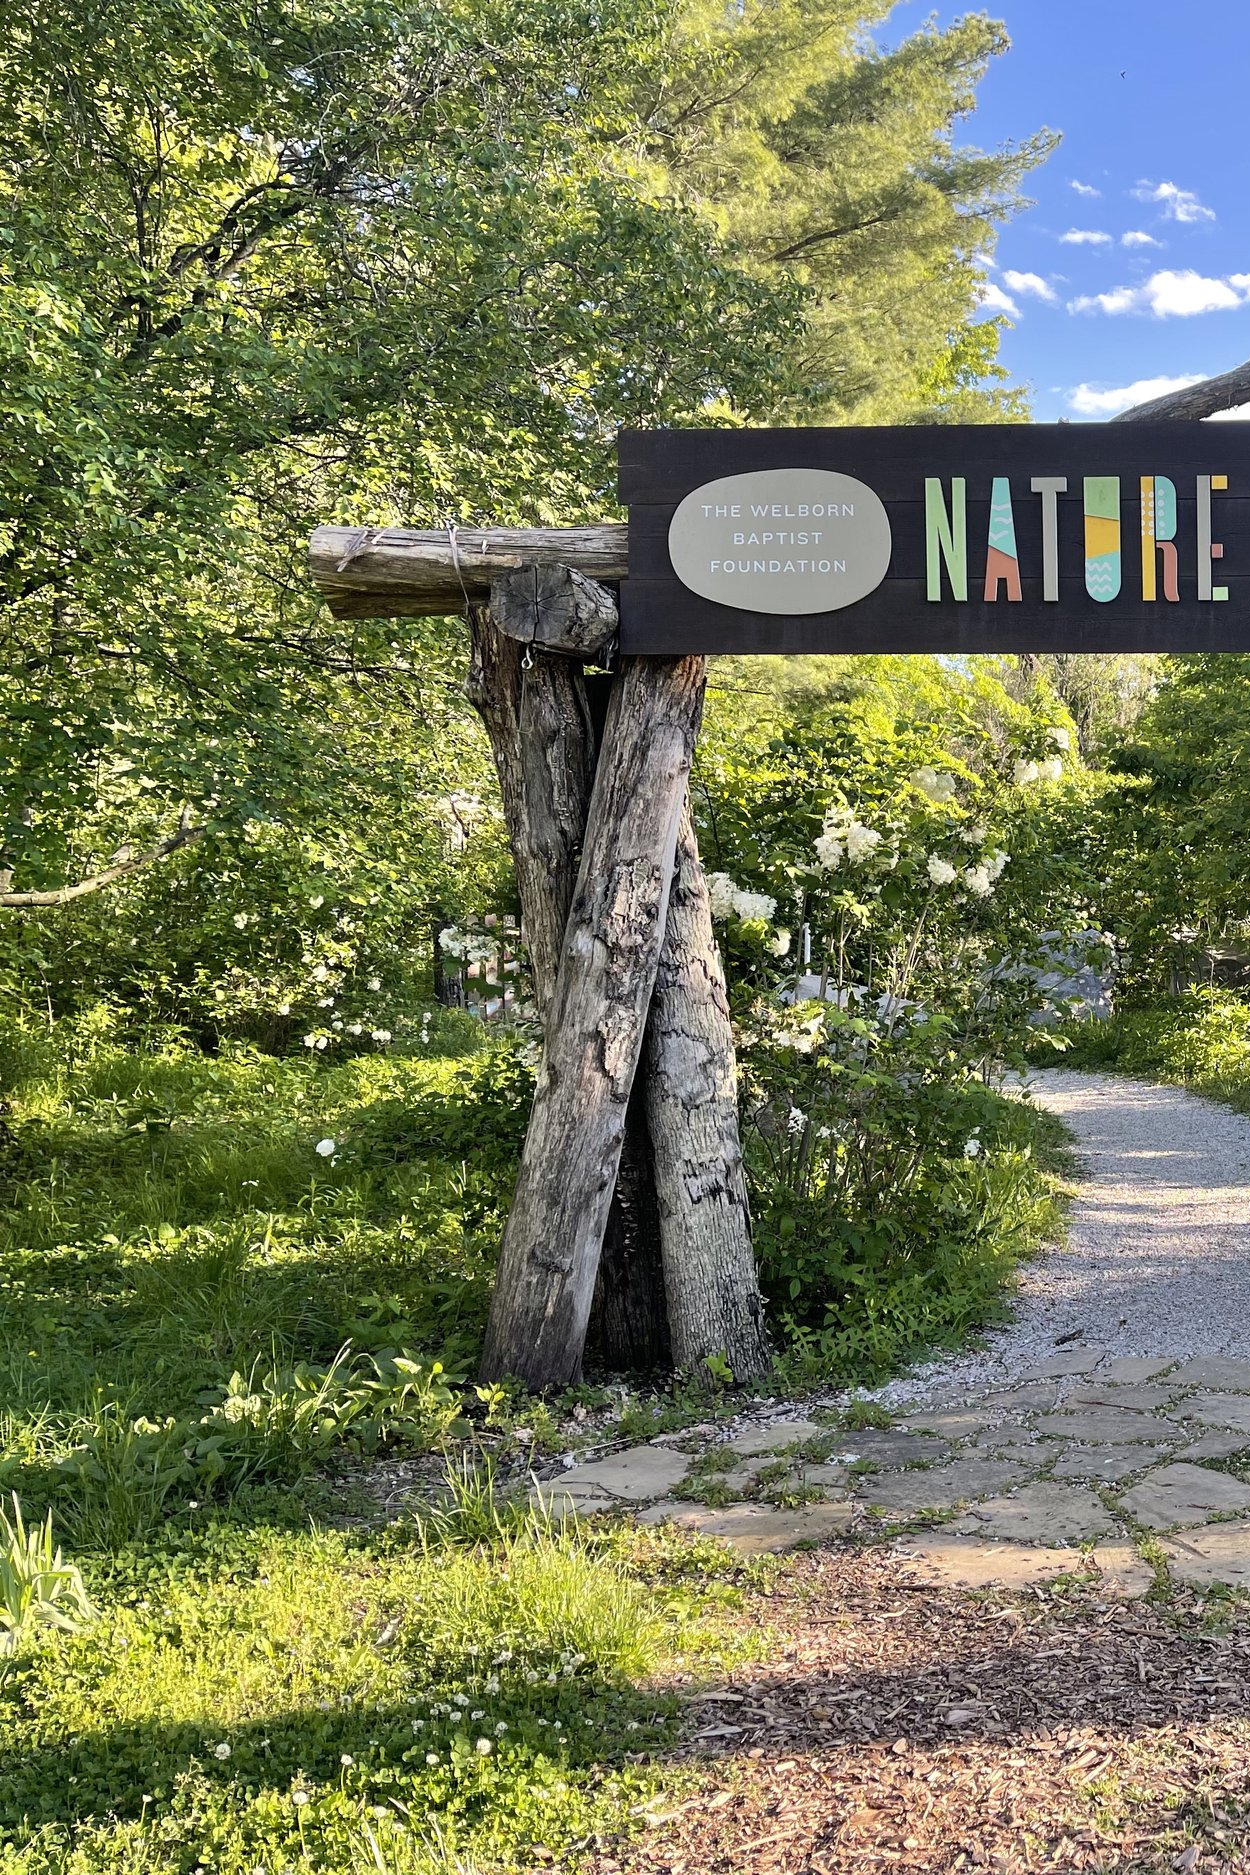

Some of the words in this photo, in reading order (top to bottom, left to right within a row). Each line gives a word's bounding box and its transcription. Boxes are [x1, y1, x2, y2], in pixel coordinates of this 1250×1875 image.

[701, 504, 741, 518] THE
[750, 503, 855, 517] WELBORN
[733, 531, 823, 545] BAPTIST
[924, 474, 1229, 602] NATURE
[710, 559, 847, 573] FOUNDATION
